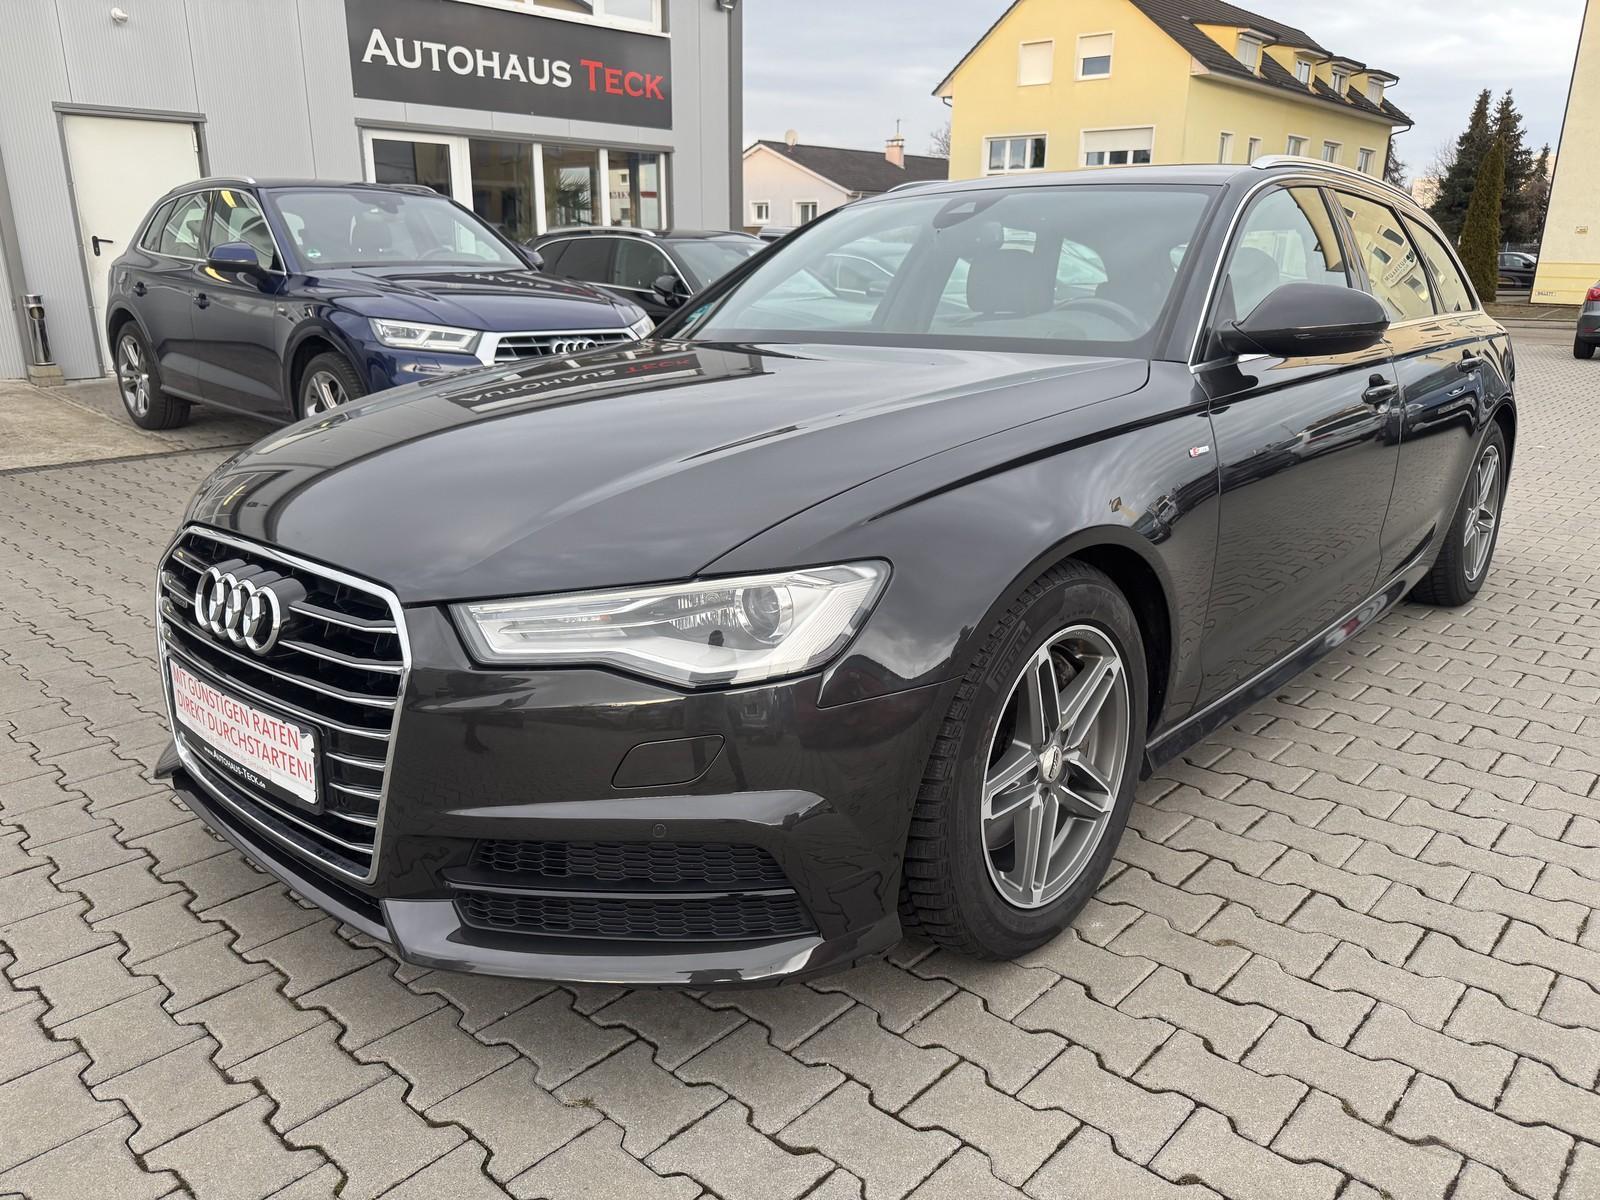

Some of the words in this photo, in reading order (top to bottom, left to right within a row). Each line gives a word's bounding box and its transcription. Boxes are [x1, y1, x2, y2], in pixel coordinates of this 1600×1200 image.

[361, 28, 573, 88] AUTOHAUS
[580, 58, 665, 100] TECK
[173, 666, 186, 689] MIT
[252, 712, 299, 750] RATEN
[177, 689, 205, 726] DIREKT
[207, 712, 313, 784] DURCHSTARTEN!
